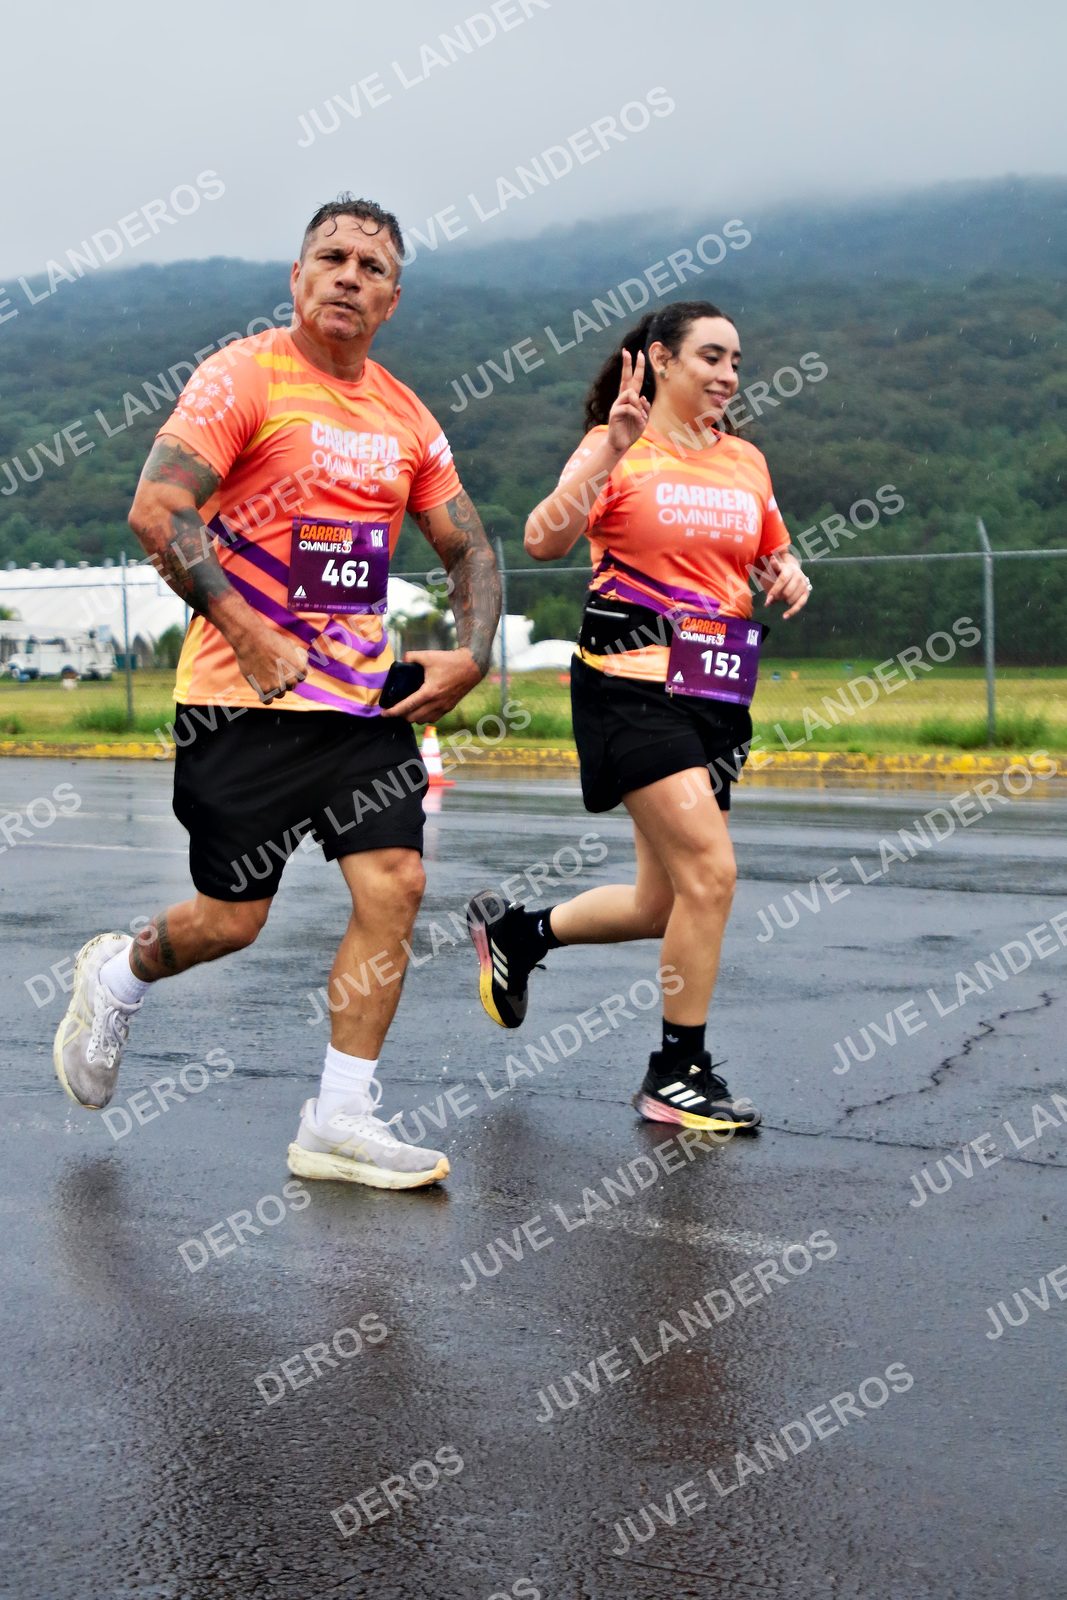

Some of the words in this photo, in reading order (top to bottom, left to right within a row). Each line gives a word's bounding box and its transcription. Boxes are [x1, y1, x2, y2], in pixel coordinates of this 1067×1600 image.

[311, 420, 400, 461] CARRERA
[656, 482, 758, 514] CARRERA
[300, 524, 353, 541] CARRERA
[321, 559, 369, 587] 462
[682, 617, 727, 635] CARRERA
[701, 650, 741, 679] 152
